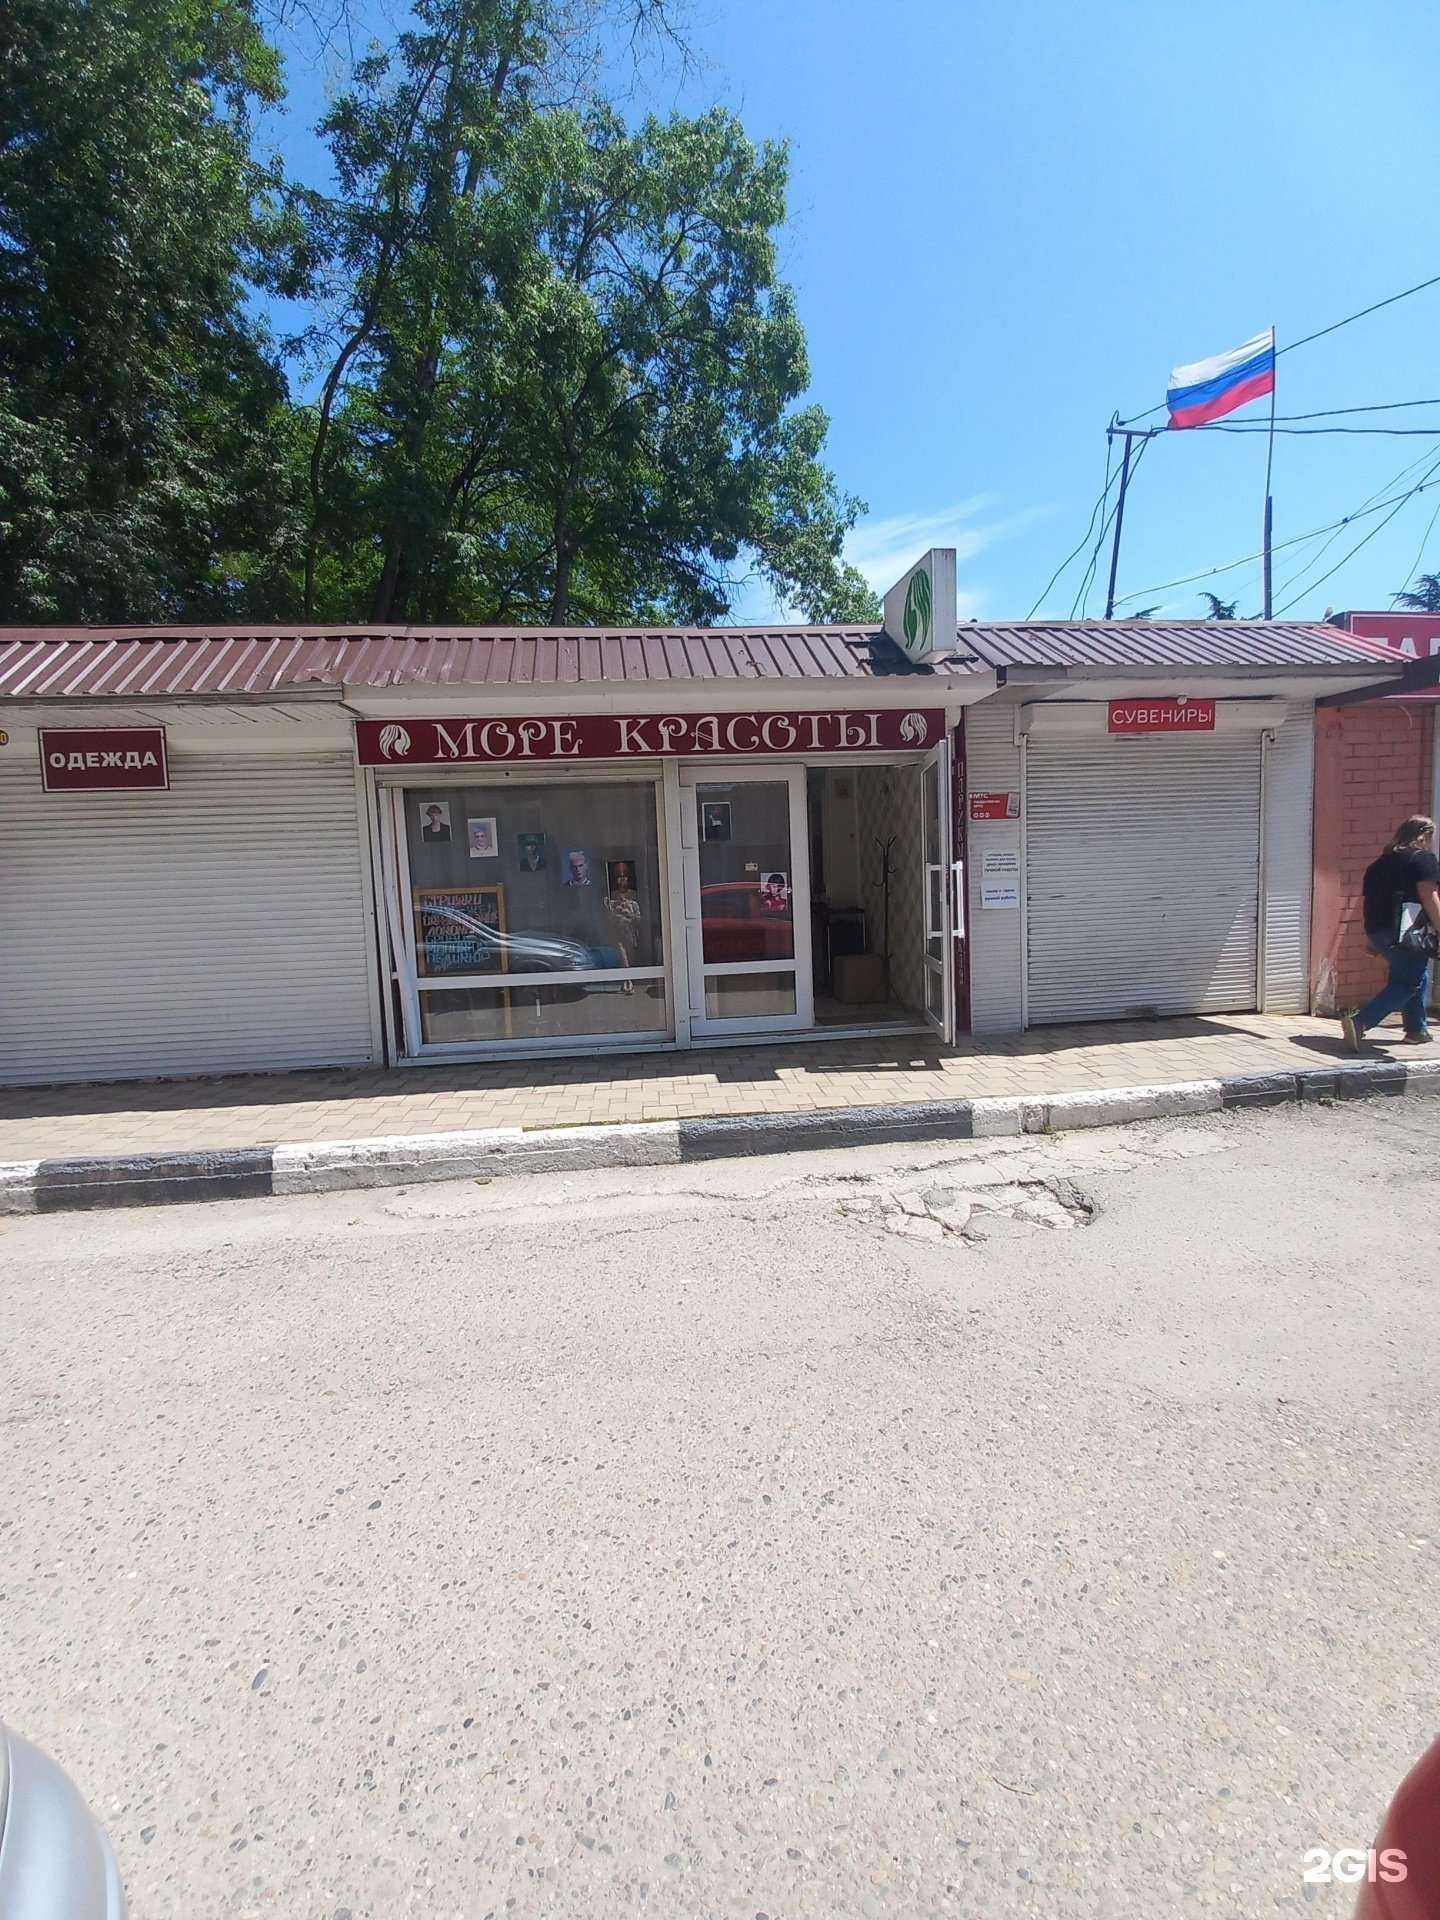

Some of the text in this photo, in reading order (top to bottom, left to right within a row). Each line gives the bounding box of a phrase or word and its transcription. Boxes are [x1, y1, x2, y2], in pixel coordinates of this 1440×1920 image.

[1112, 709, 1212, 724] СУВЕНИРЫ
[432, 714, 882, 758] МОРЕ КРАСОТЫ
[49, 751, 158, 770] ОДЕЖДА
